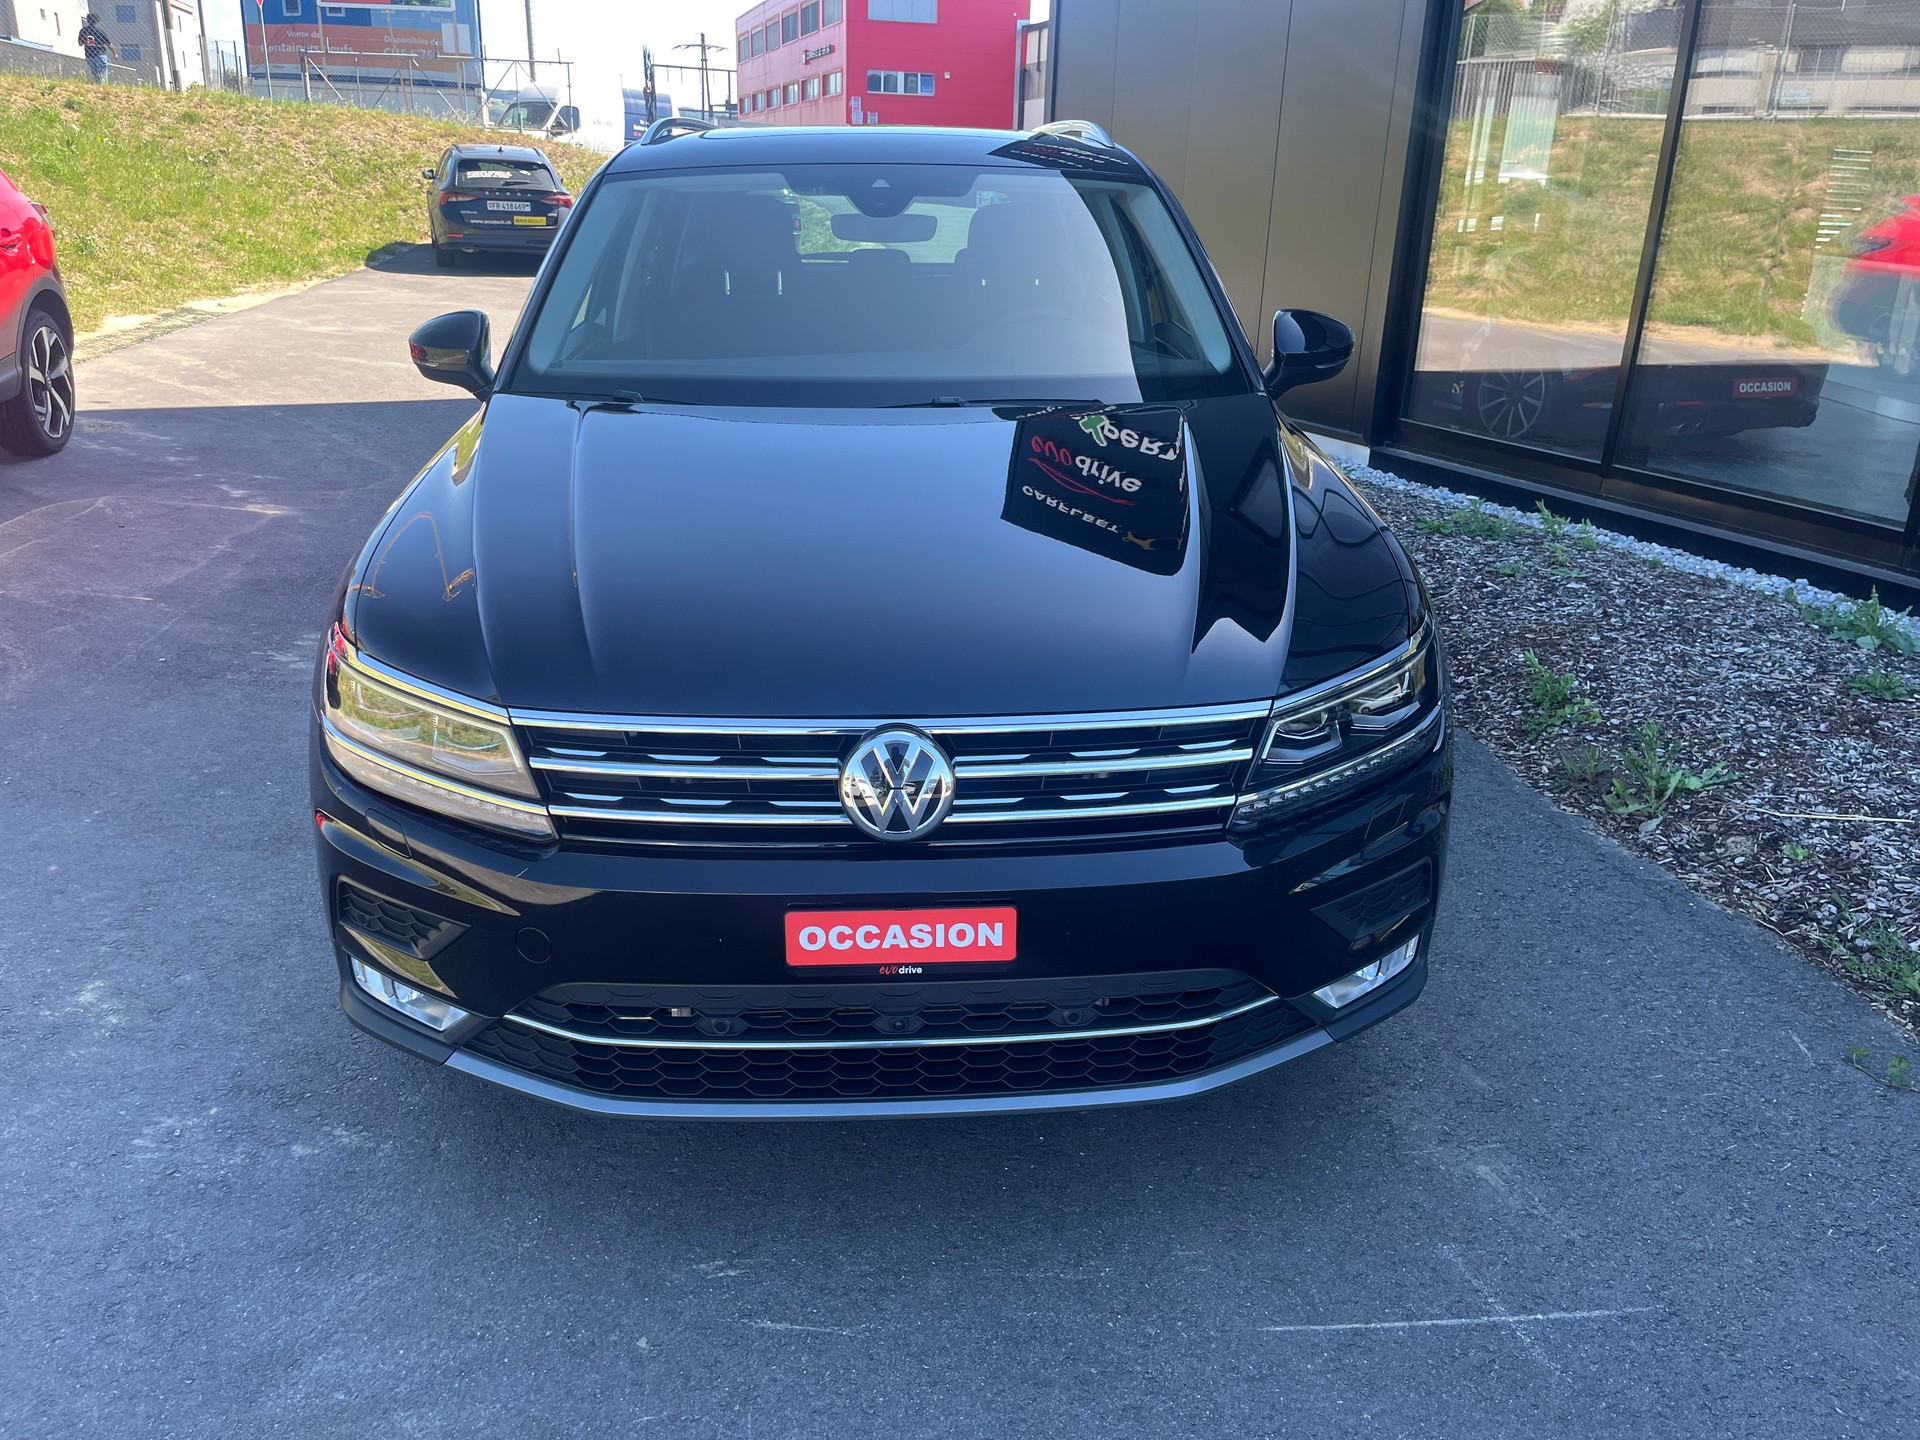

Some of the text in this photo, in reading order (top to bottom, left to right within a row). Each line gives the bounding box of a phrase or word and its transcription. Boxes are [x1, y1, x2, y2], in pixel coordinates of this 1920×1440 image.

[286, 30, 309, 38] Vente
[1739, 381, 1791, 393] OCCASION
[799, 923, 1003, 950] OCCASION
